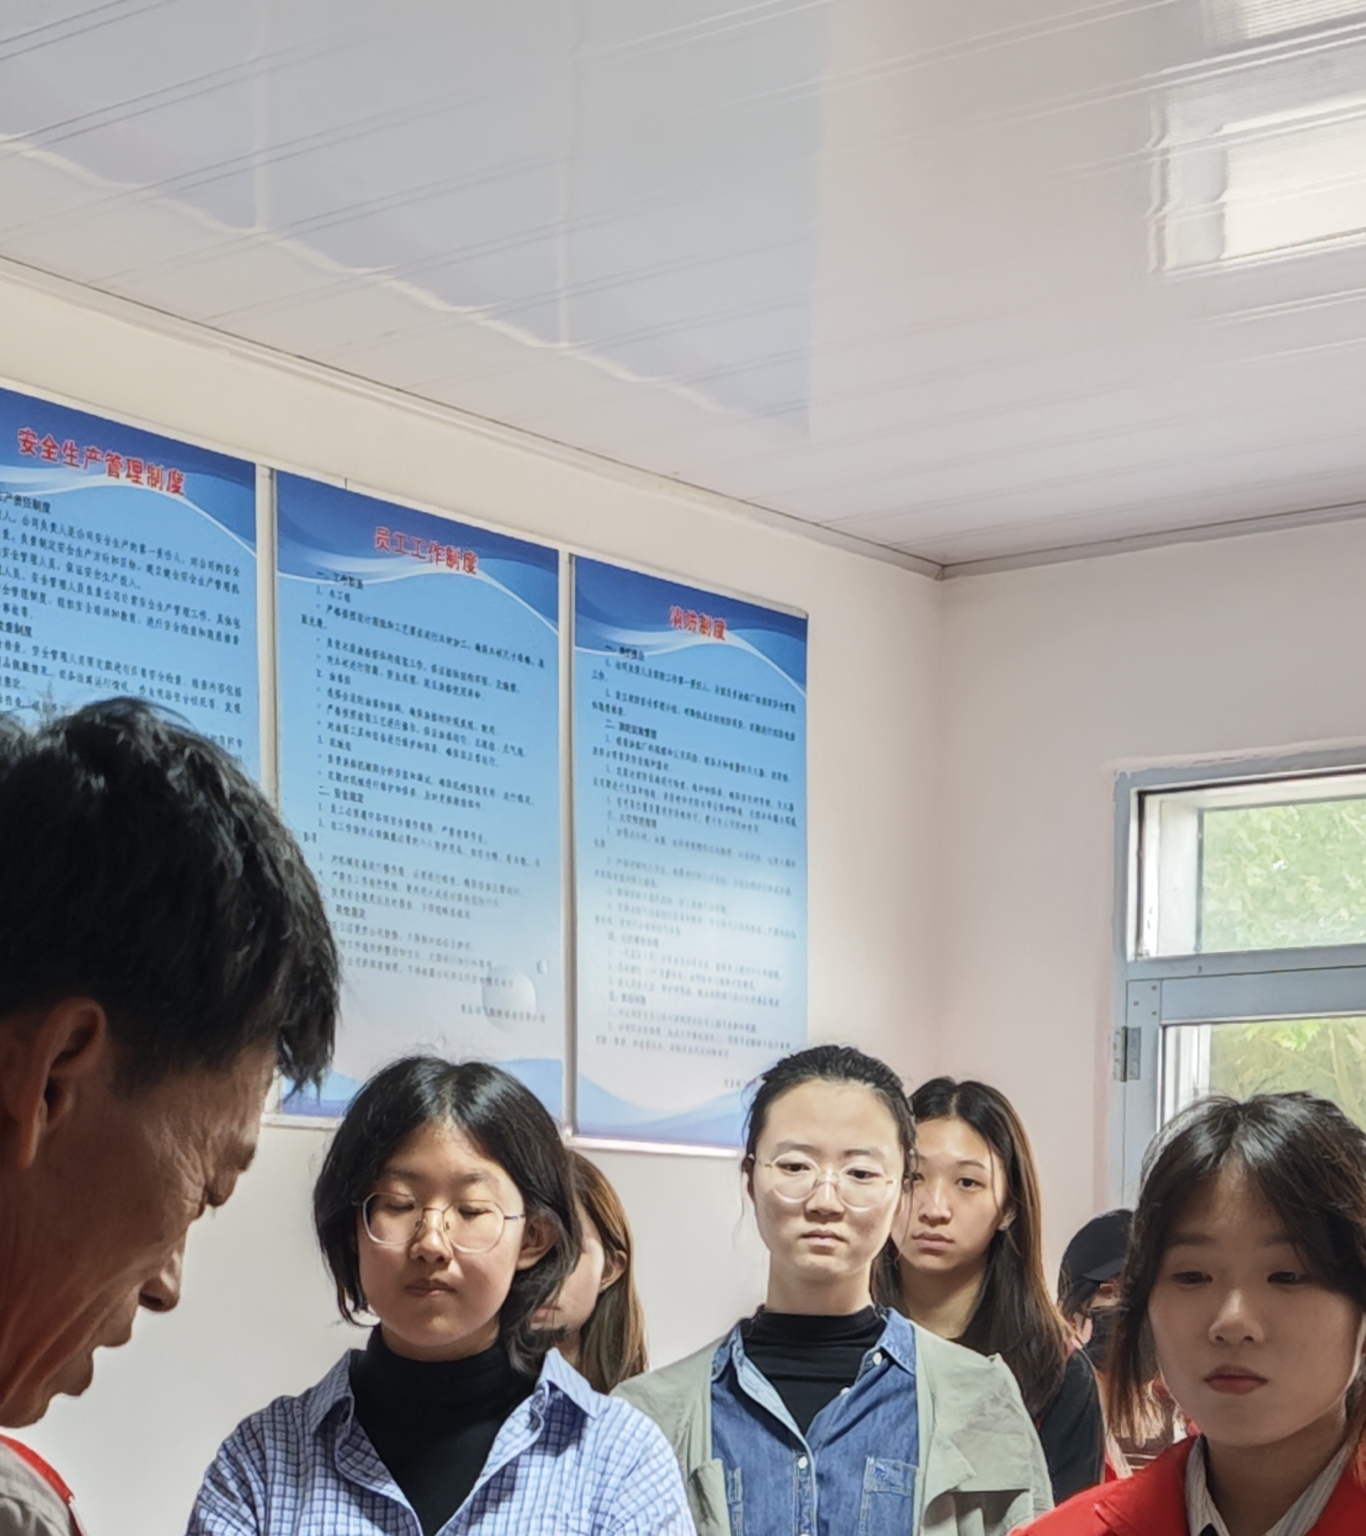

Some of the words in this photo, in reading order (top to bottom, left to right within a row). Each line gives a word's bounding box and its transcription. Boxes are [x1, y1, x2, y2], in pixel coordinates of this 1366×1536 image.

[16, 423, 185, 499] 安全生产管理制度
[373, 523, 479, 577] 员工工作制度
